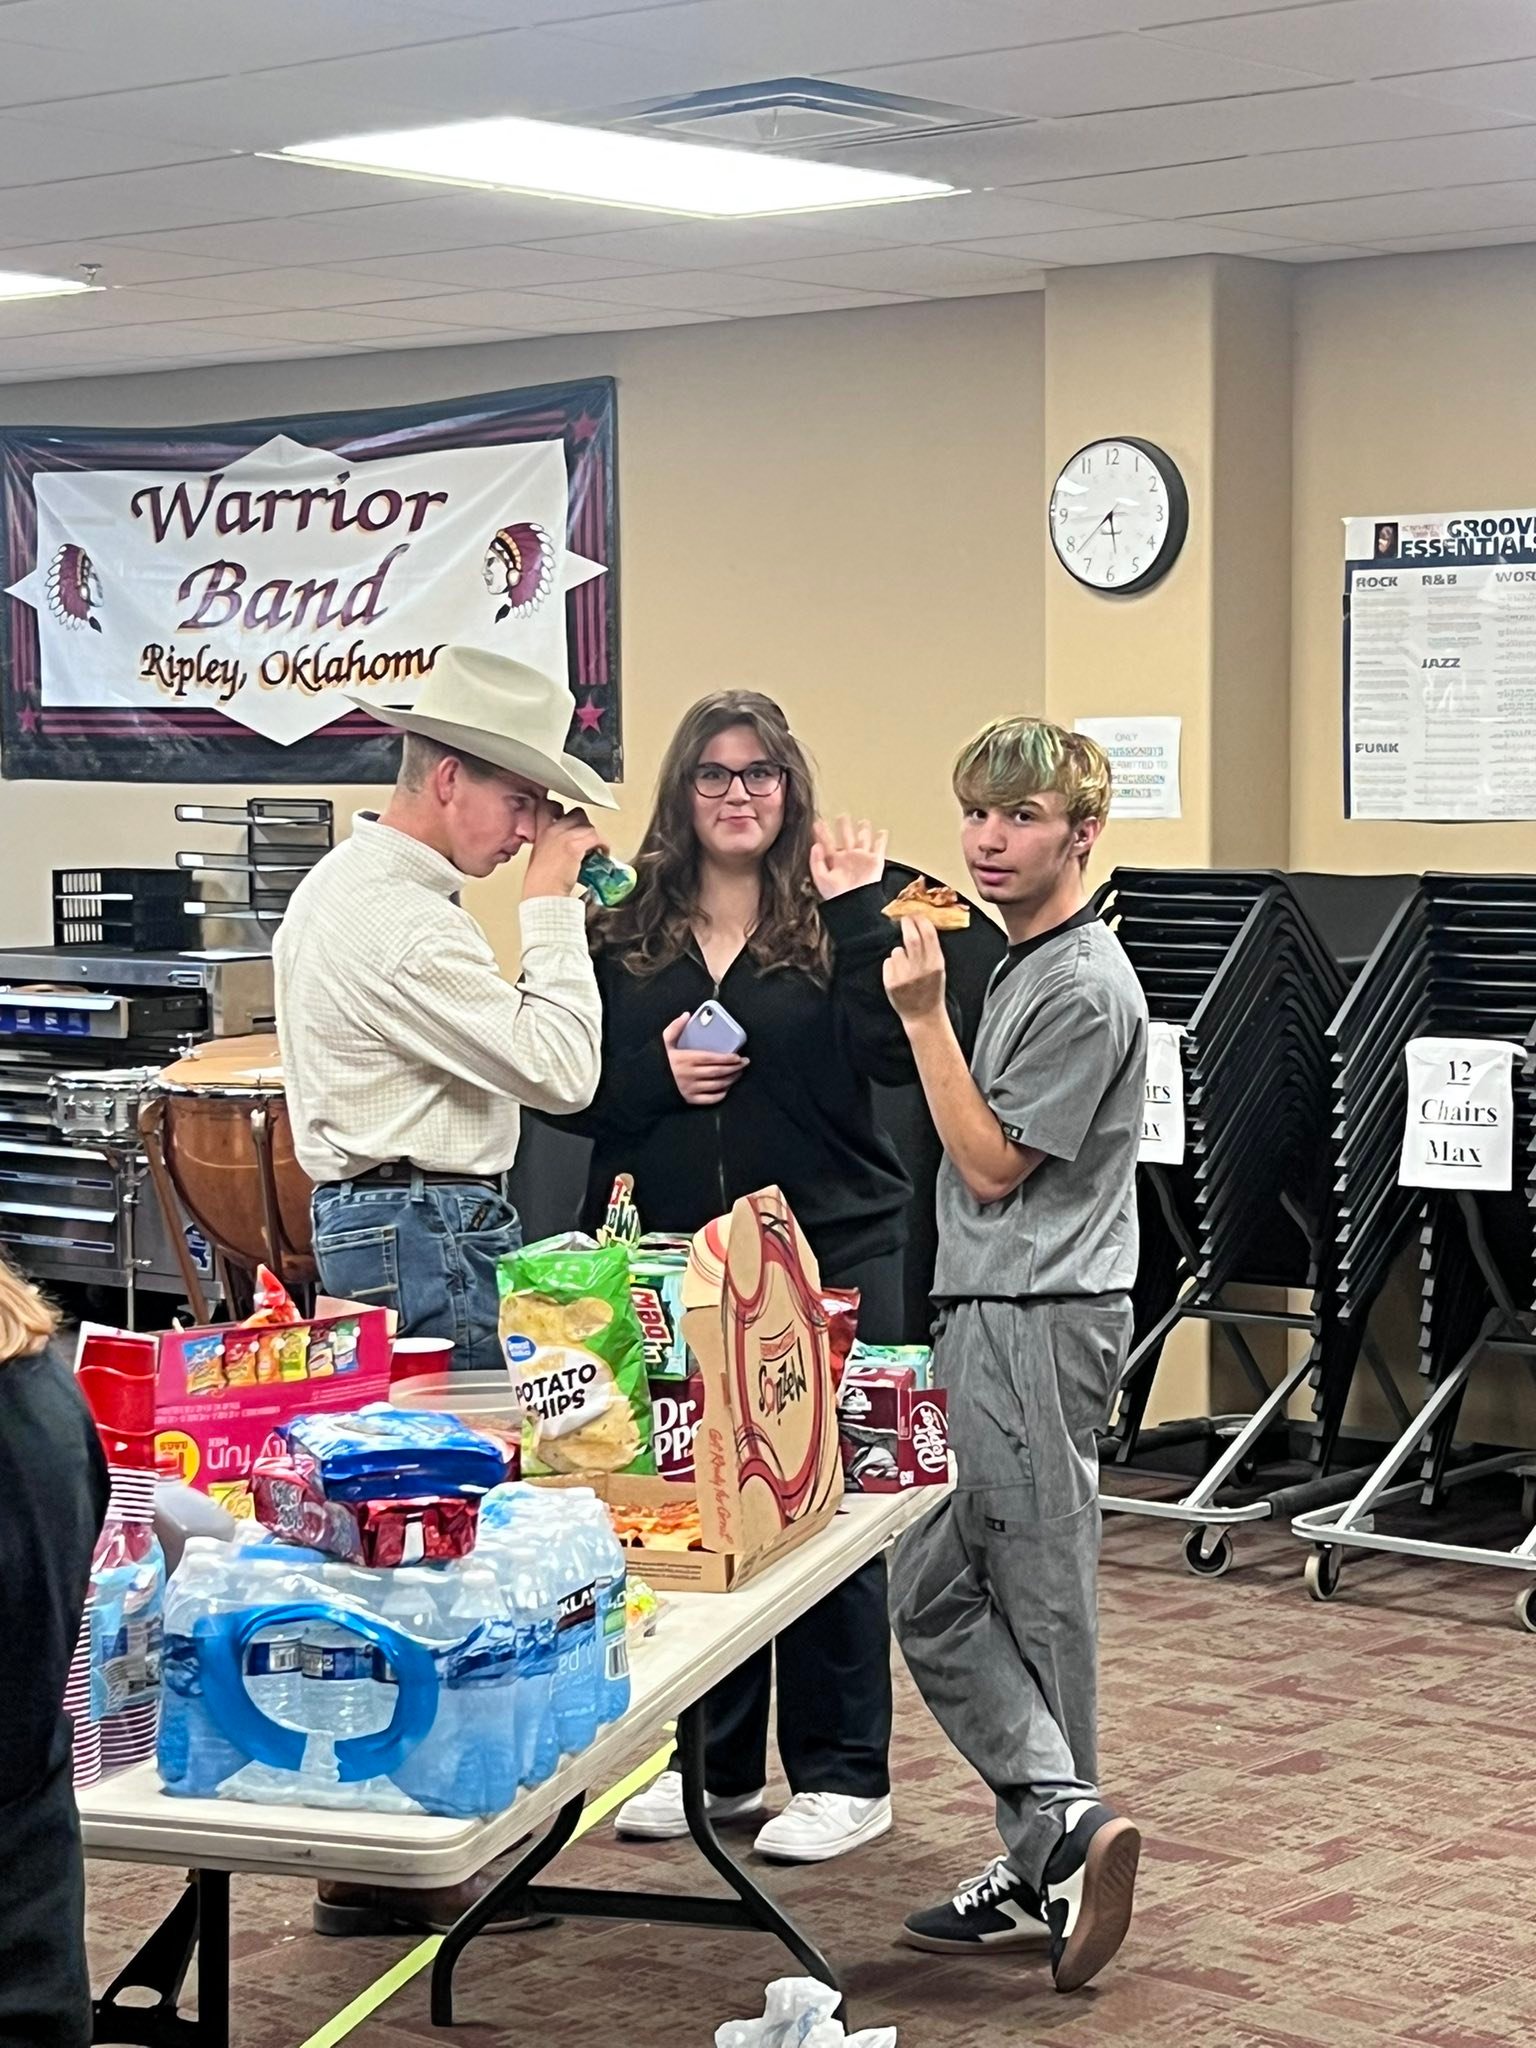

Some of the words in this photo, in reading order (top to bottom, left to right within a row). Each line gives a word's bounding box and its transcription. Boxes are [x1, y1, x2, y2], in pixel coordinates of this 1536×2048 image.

[1082, 457, 1092, 474] 11
[1105, 448, 1120, 466] 12
[1148, 476, 1158, 492] 2
[130, 471, 449, 543] Warrior
[1155, 505, 1164, 522] 3
[1059, 508, 1068, 525] 9
[1447, 517, 1536, 538] GROOV
[1066, 536, 1076, 553] 8
[1146, 535, 1156, 551] 4
[1401, 535, 1536, 558] ESSENTIAL
[1083, 558, 1092, 574] 7
[1106, 565, 1115, 582] 6
[1132, 557, 1140, 573] 5
[176, 543, 411, 632] Band
[1356, 576, 1398, 588] ROCK
[1421, 574, 1457, 586] R&B
[140, 643, 248, 701] Ripley,
[1421, 658, 1461, 669] JAZZ
[1355, 743, 1399, 753] FUNK
[1449, 1060, 1472, 1081] 12
[1145, 1079, 1171, 1100] irs
[1421, 1098, 1498, 1123] Chairs
[1427, 1139, 1482, 1163] Max
[515, 1364, 597, 1404] POTATO
[652, 1397, 697, 1434] Dr
